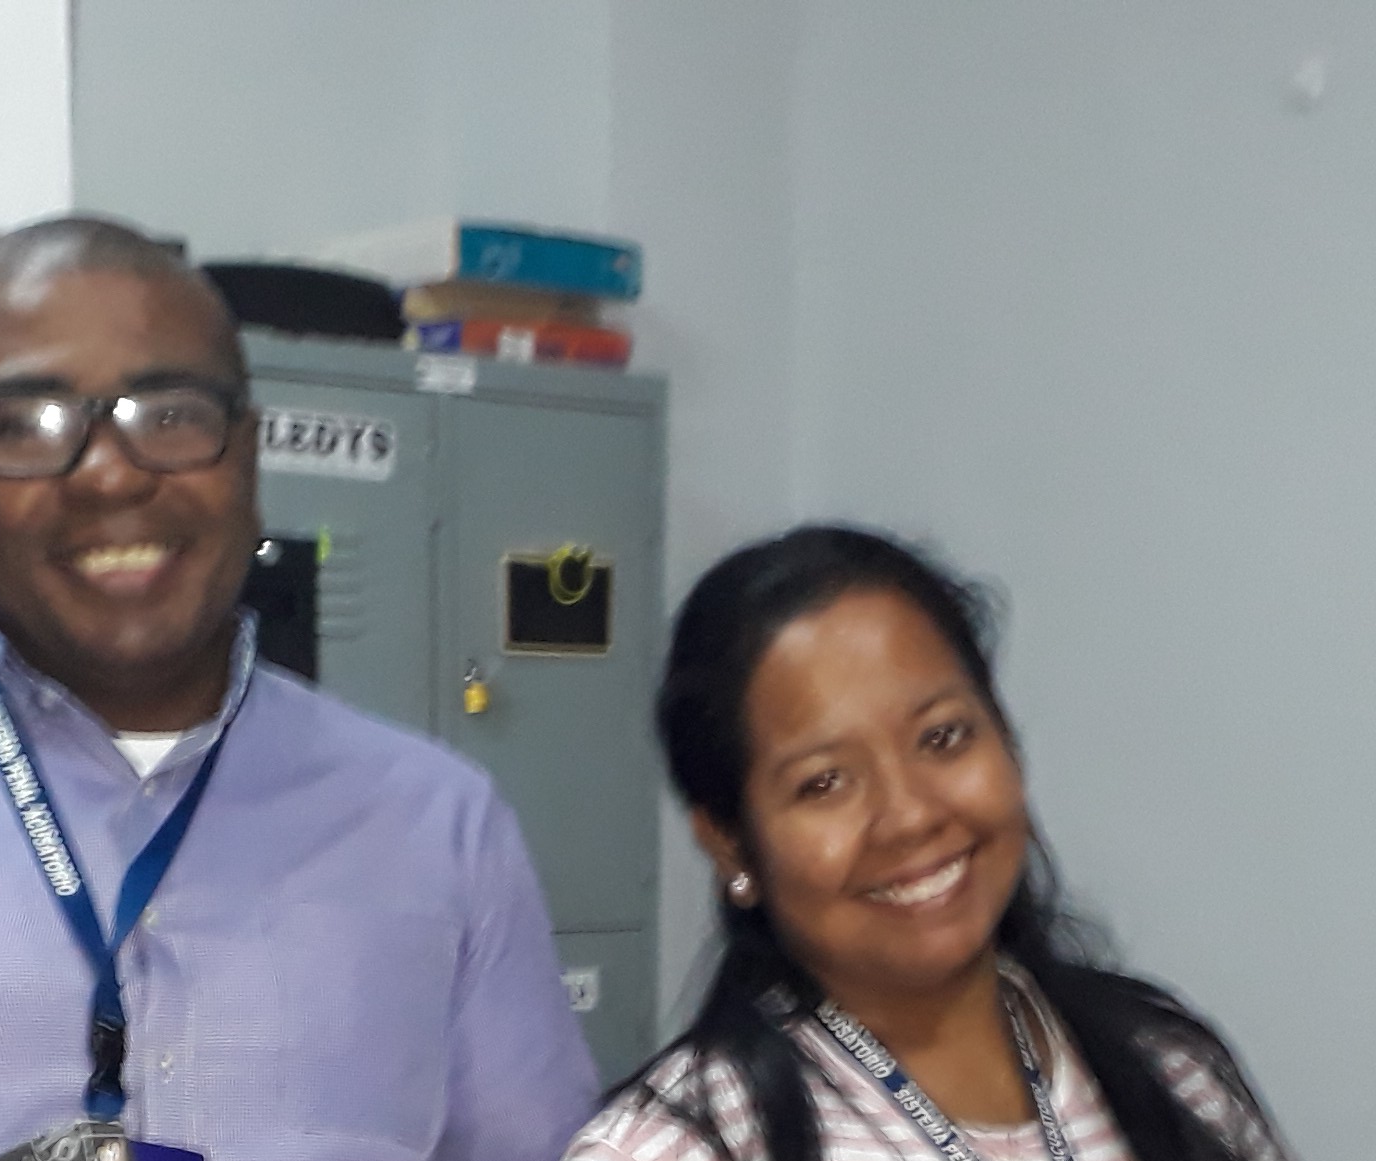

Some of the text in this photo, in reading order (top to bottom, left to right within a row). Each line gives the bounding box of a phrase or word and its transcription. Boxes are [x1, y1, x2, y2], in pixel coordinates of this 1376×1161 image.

[2, 750, 47, 809] PENAL
[21, 803, 81, 896] ACUSATORIO
[893, 1080, 955, 1146] SISTEMA
